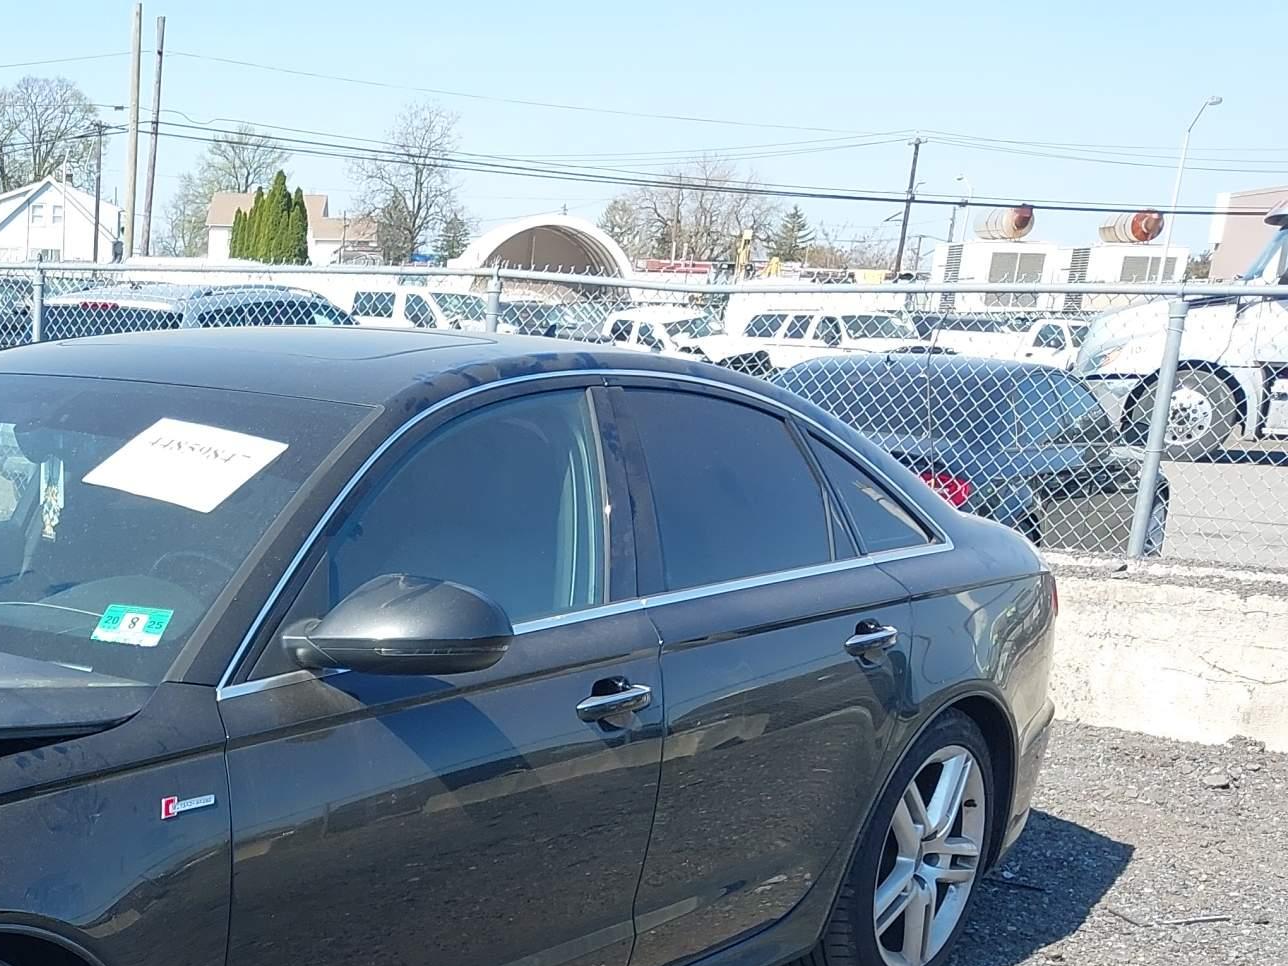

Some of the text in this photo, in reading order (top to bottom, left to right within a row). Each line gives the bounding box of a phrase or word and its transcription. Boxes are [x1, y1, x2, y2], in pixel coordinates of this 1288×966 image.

[104, 615, 164, 630] 20 8 25
